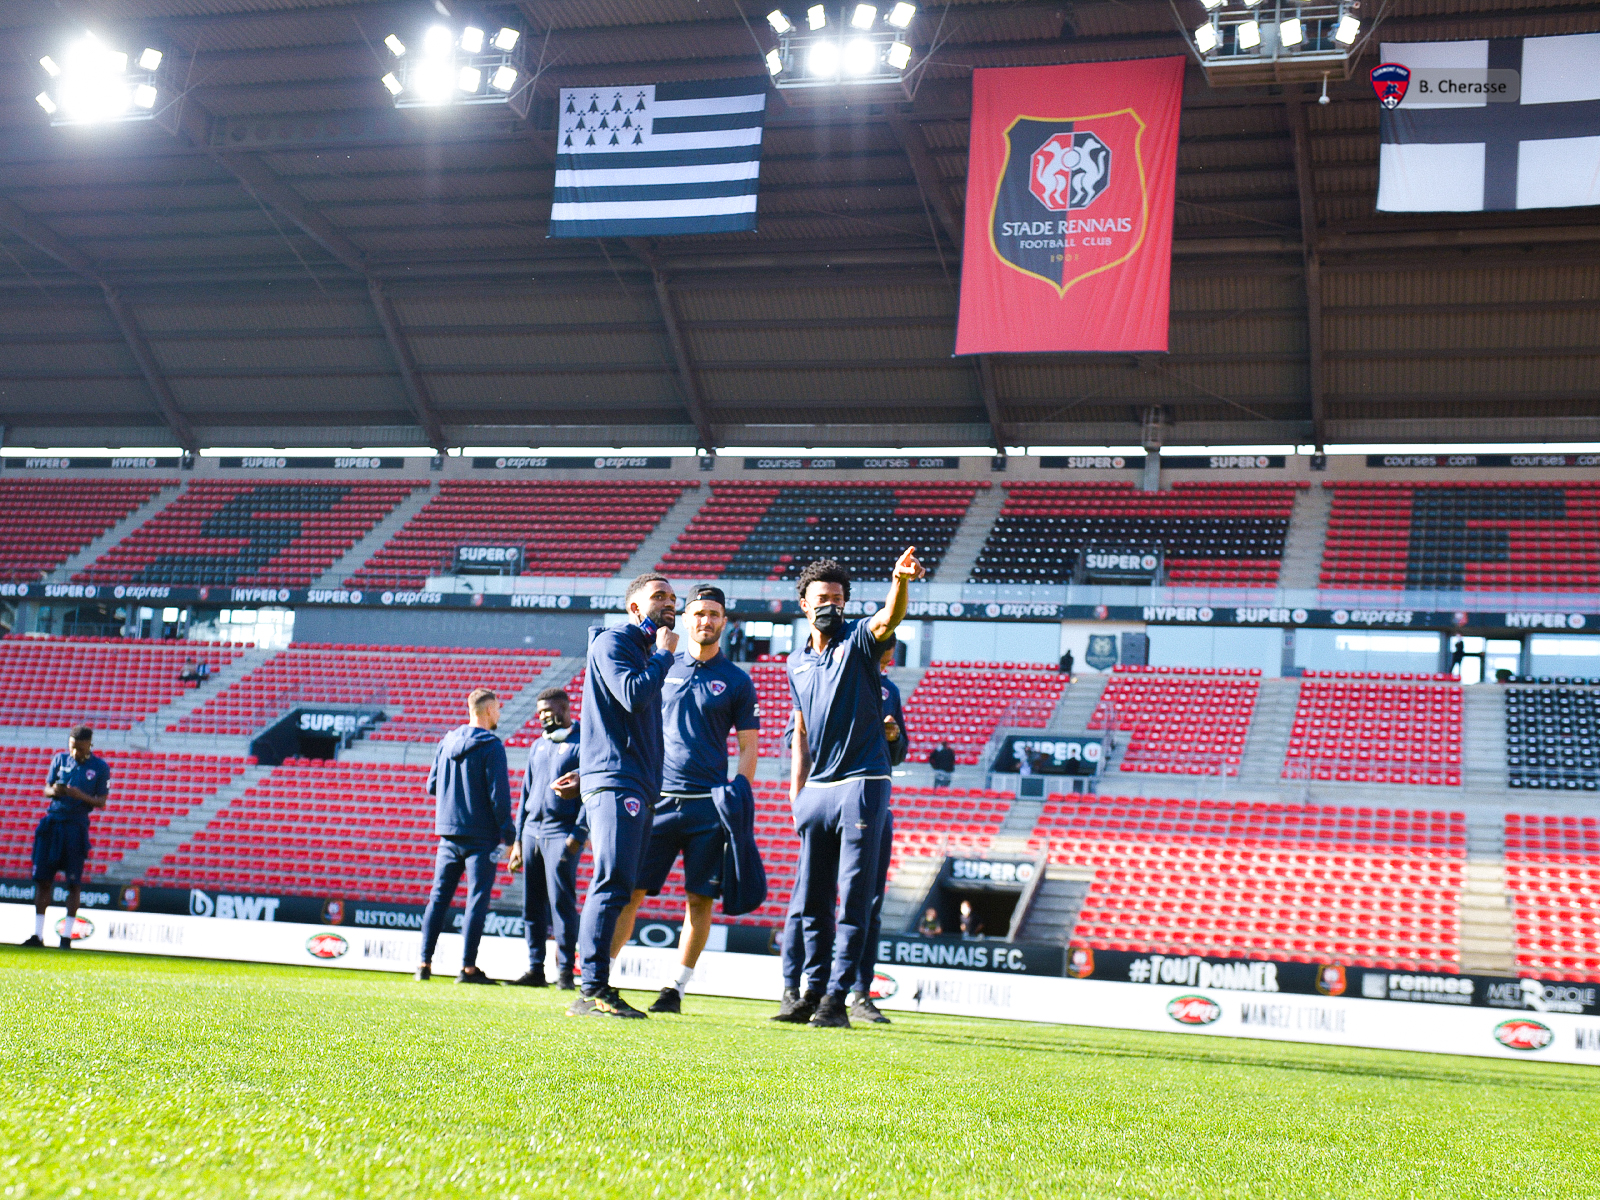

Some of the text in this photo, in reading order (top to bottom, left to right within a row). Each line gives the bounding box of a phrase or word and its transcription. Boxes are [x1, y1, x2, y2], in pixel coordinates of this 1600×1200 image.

[1001, 217, 1132, 236] STADE RENNAIS
[1019, 237, 1112, 249] FOOTBALL CLUB
[25, 458, 60, 468] HYPER
[111, 458, 147, 468] HYPER
[241, 457, 276, 468] SUPER
[334, 457, 370, 468] SUPER
[507, 457, 548, 468] express
[605, 457, 648, 468] express
[757, 458, 802, 468] courses
[863, 458, 910, 468] courses
[1068, 457, 1112, 469] SUPER
[1209, 457, 1255, 469] SUPER
[1383, 456, 1437, 467] courses
[1510, 456, 1566, 467] courses
[459, 547, 505, 561] SUPER
[1086, 554, 1141, 569] SUPER
[44, 585, 84, 598] SUPER
[126, 586, 171, 600] express
[235, 588, 278, 602] HYPER
[307, 589, 350, 603] SUPER
[394, 591, 442, 606] express
[511, 594, 557, 608] HYPER
[590, 596, 626, 609] SUPE
[907, 602, 949, 615] UPER
[1001, 604, 1058, 618] express
[1143, 606, 1197, 621] HYPER
[1235, 608, 1291, 623] SUPER
[1350, 610, 1413, 625] express
[1505, 613, 1567, 628] HYPER
[300, 713, 356, 732] SUPER
[953, 860, 1016, 881] SUPER
[54, 887, 110, 906] Bragne
[216, 894, 280, 921] BWT
[355, 909, 424, 928] RISTORAN
[895, 942, 987, 967] RENNAIS
[992, 948, 1027, 970] F.C.
[1389, 974, 1474, 995] rennes
